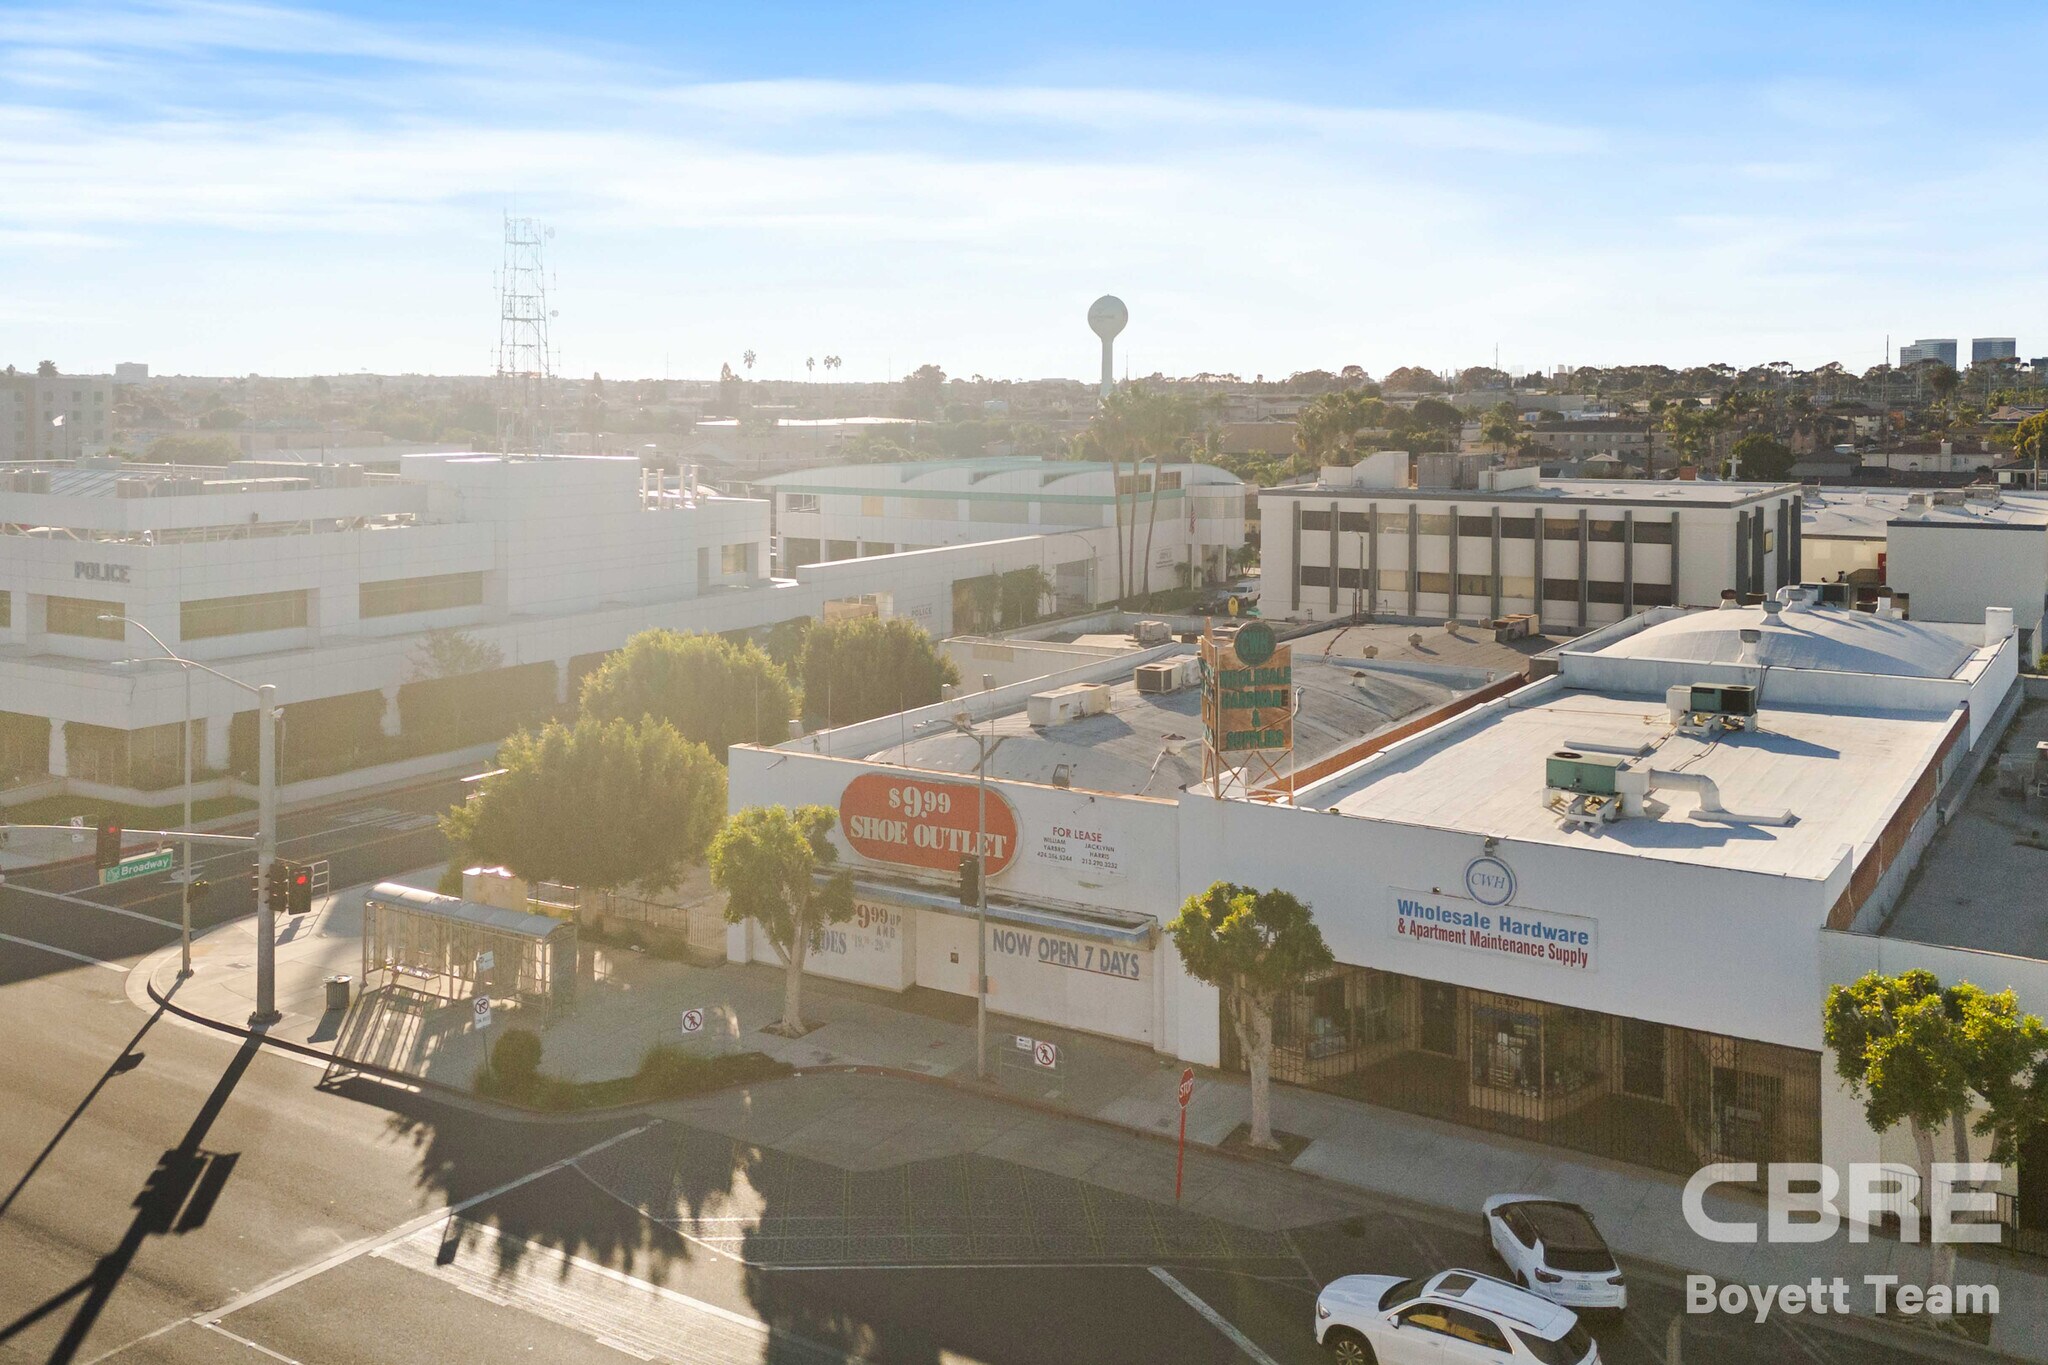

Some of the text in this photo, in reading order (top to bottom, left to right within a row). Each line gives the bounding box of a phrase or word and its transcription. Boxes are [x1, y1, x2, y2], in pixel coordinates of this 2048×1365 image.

[75, 561, 130, 583] POLICE
[1221, 689, 1288, 709] HARDWARE
[888, 786, 950, 818] $9.99
[850, 814, 1007, 859] SHOE OUTLET
[1043, 836, 1066, 846] WILLIAM
[1052, 826, 1102, 843] FOR LEASE
[1089, 851, 1110, 860] HARRIS
[121, 858, 169, 876] Broadway
[1471, 872, 1506, 890] CWH
[890, 913, 902, 926] UP
[1397, 898, 1589, 946] Wholesale Hardware
[876, 925, 896, 939] AND
[1397, 917, 1588, 969] & Apartment Maintenance Supply
[993, 928, 1140, 978] NOW OPEN 7 DAYS
